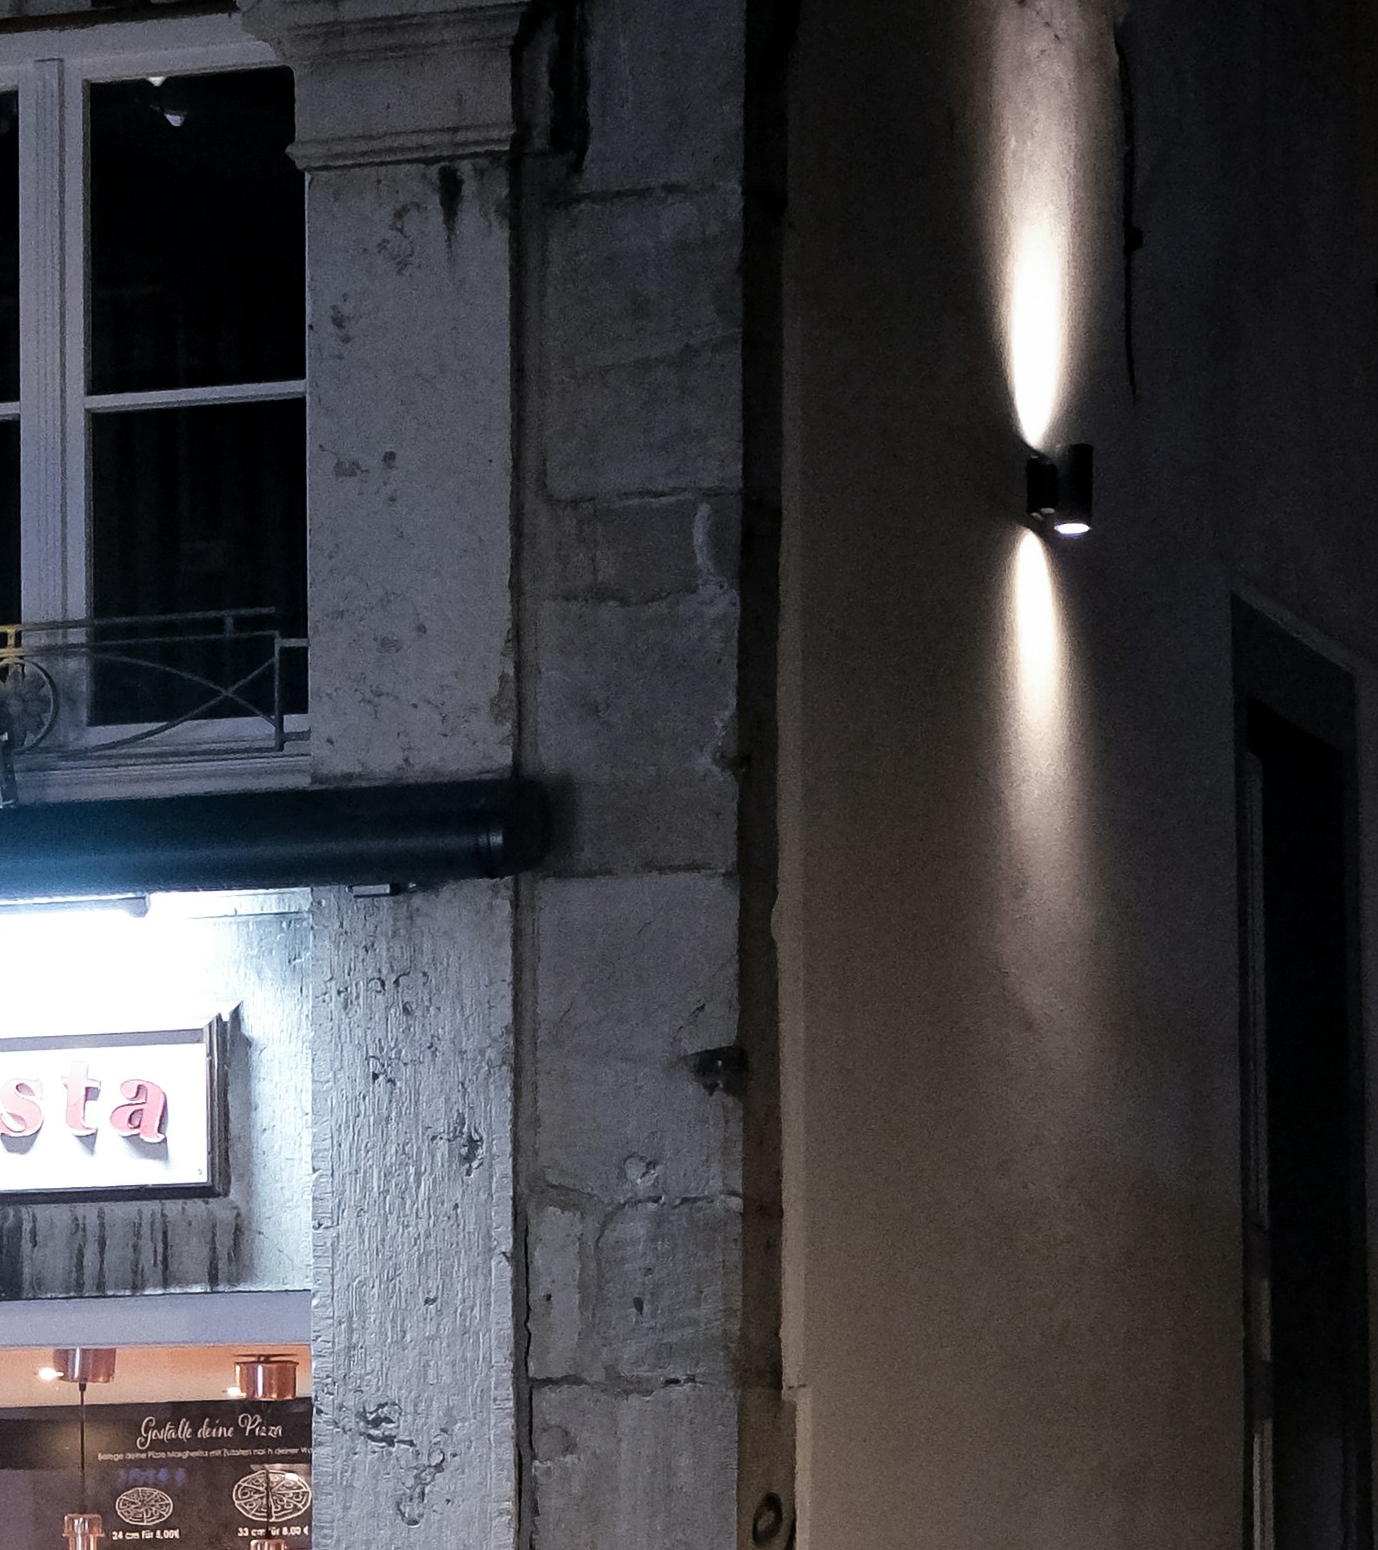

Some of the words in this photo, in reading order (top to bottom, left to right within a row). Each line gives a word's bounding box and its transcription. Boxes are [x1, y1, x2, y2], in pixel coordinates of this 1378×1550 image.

[136, 1416, 193, 1449] Gestalte
[197, 1418, 235, 1440] deine
[237, 1413, 283, 1438] Pizza
